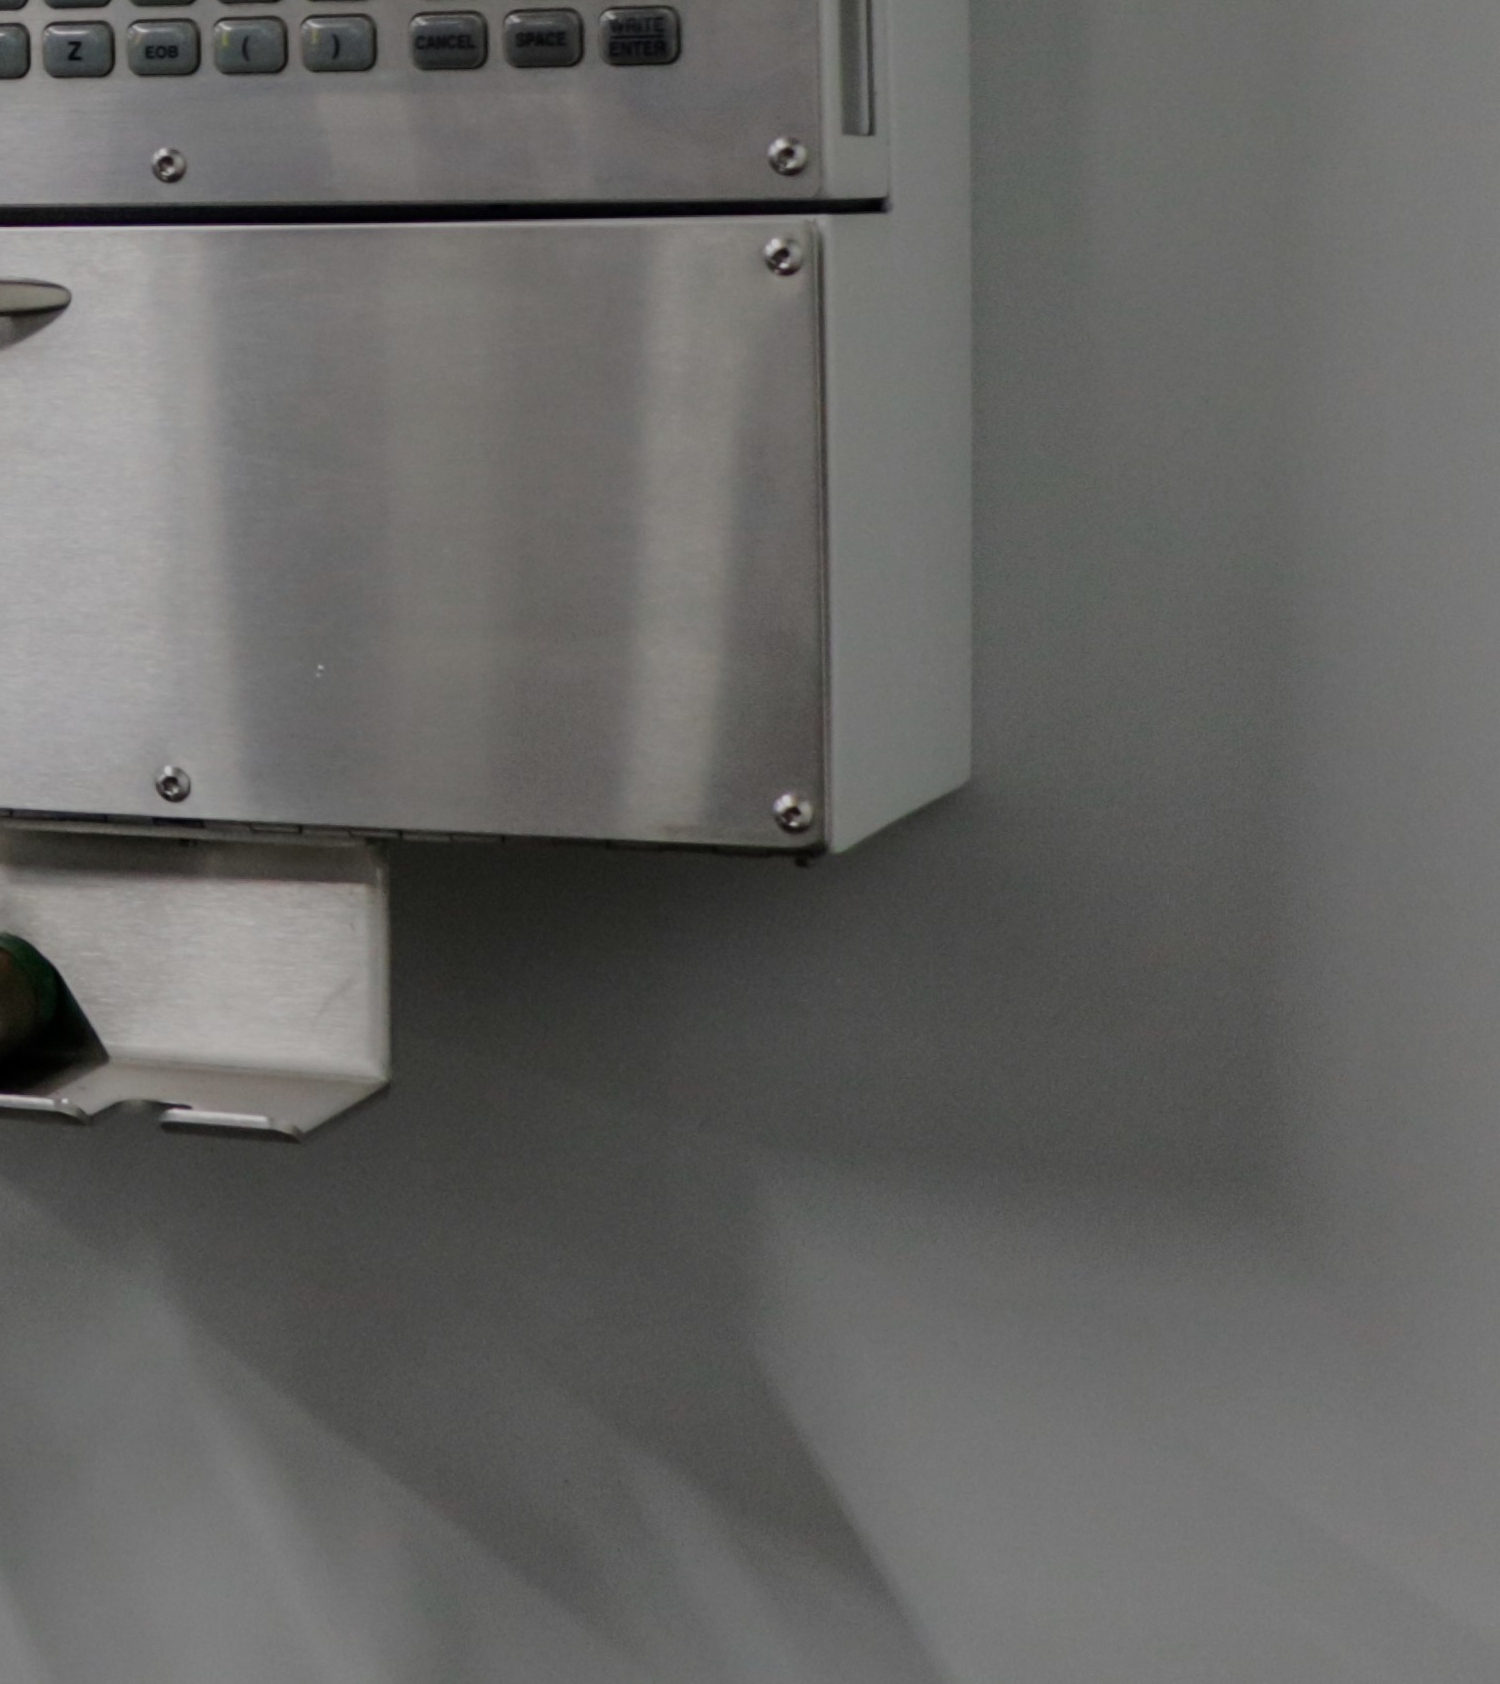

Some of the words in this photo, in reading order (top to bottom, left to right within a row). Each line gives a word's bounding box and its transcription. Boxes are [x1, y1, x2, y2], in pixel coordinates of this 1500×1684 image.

[609, 17, 665, 34] WRITE
[414, 34, 476, 50] CANCEL
[515, 31, 566, 48] SPACE
[67, 41, 82, 61] Z
[145, 45, 178, 59] EOB
[608, 40, 667, 57] ENTER
